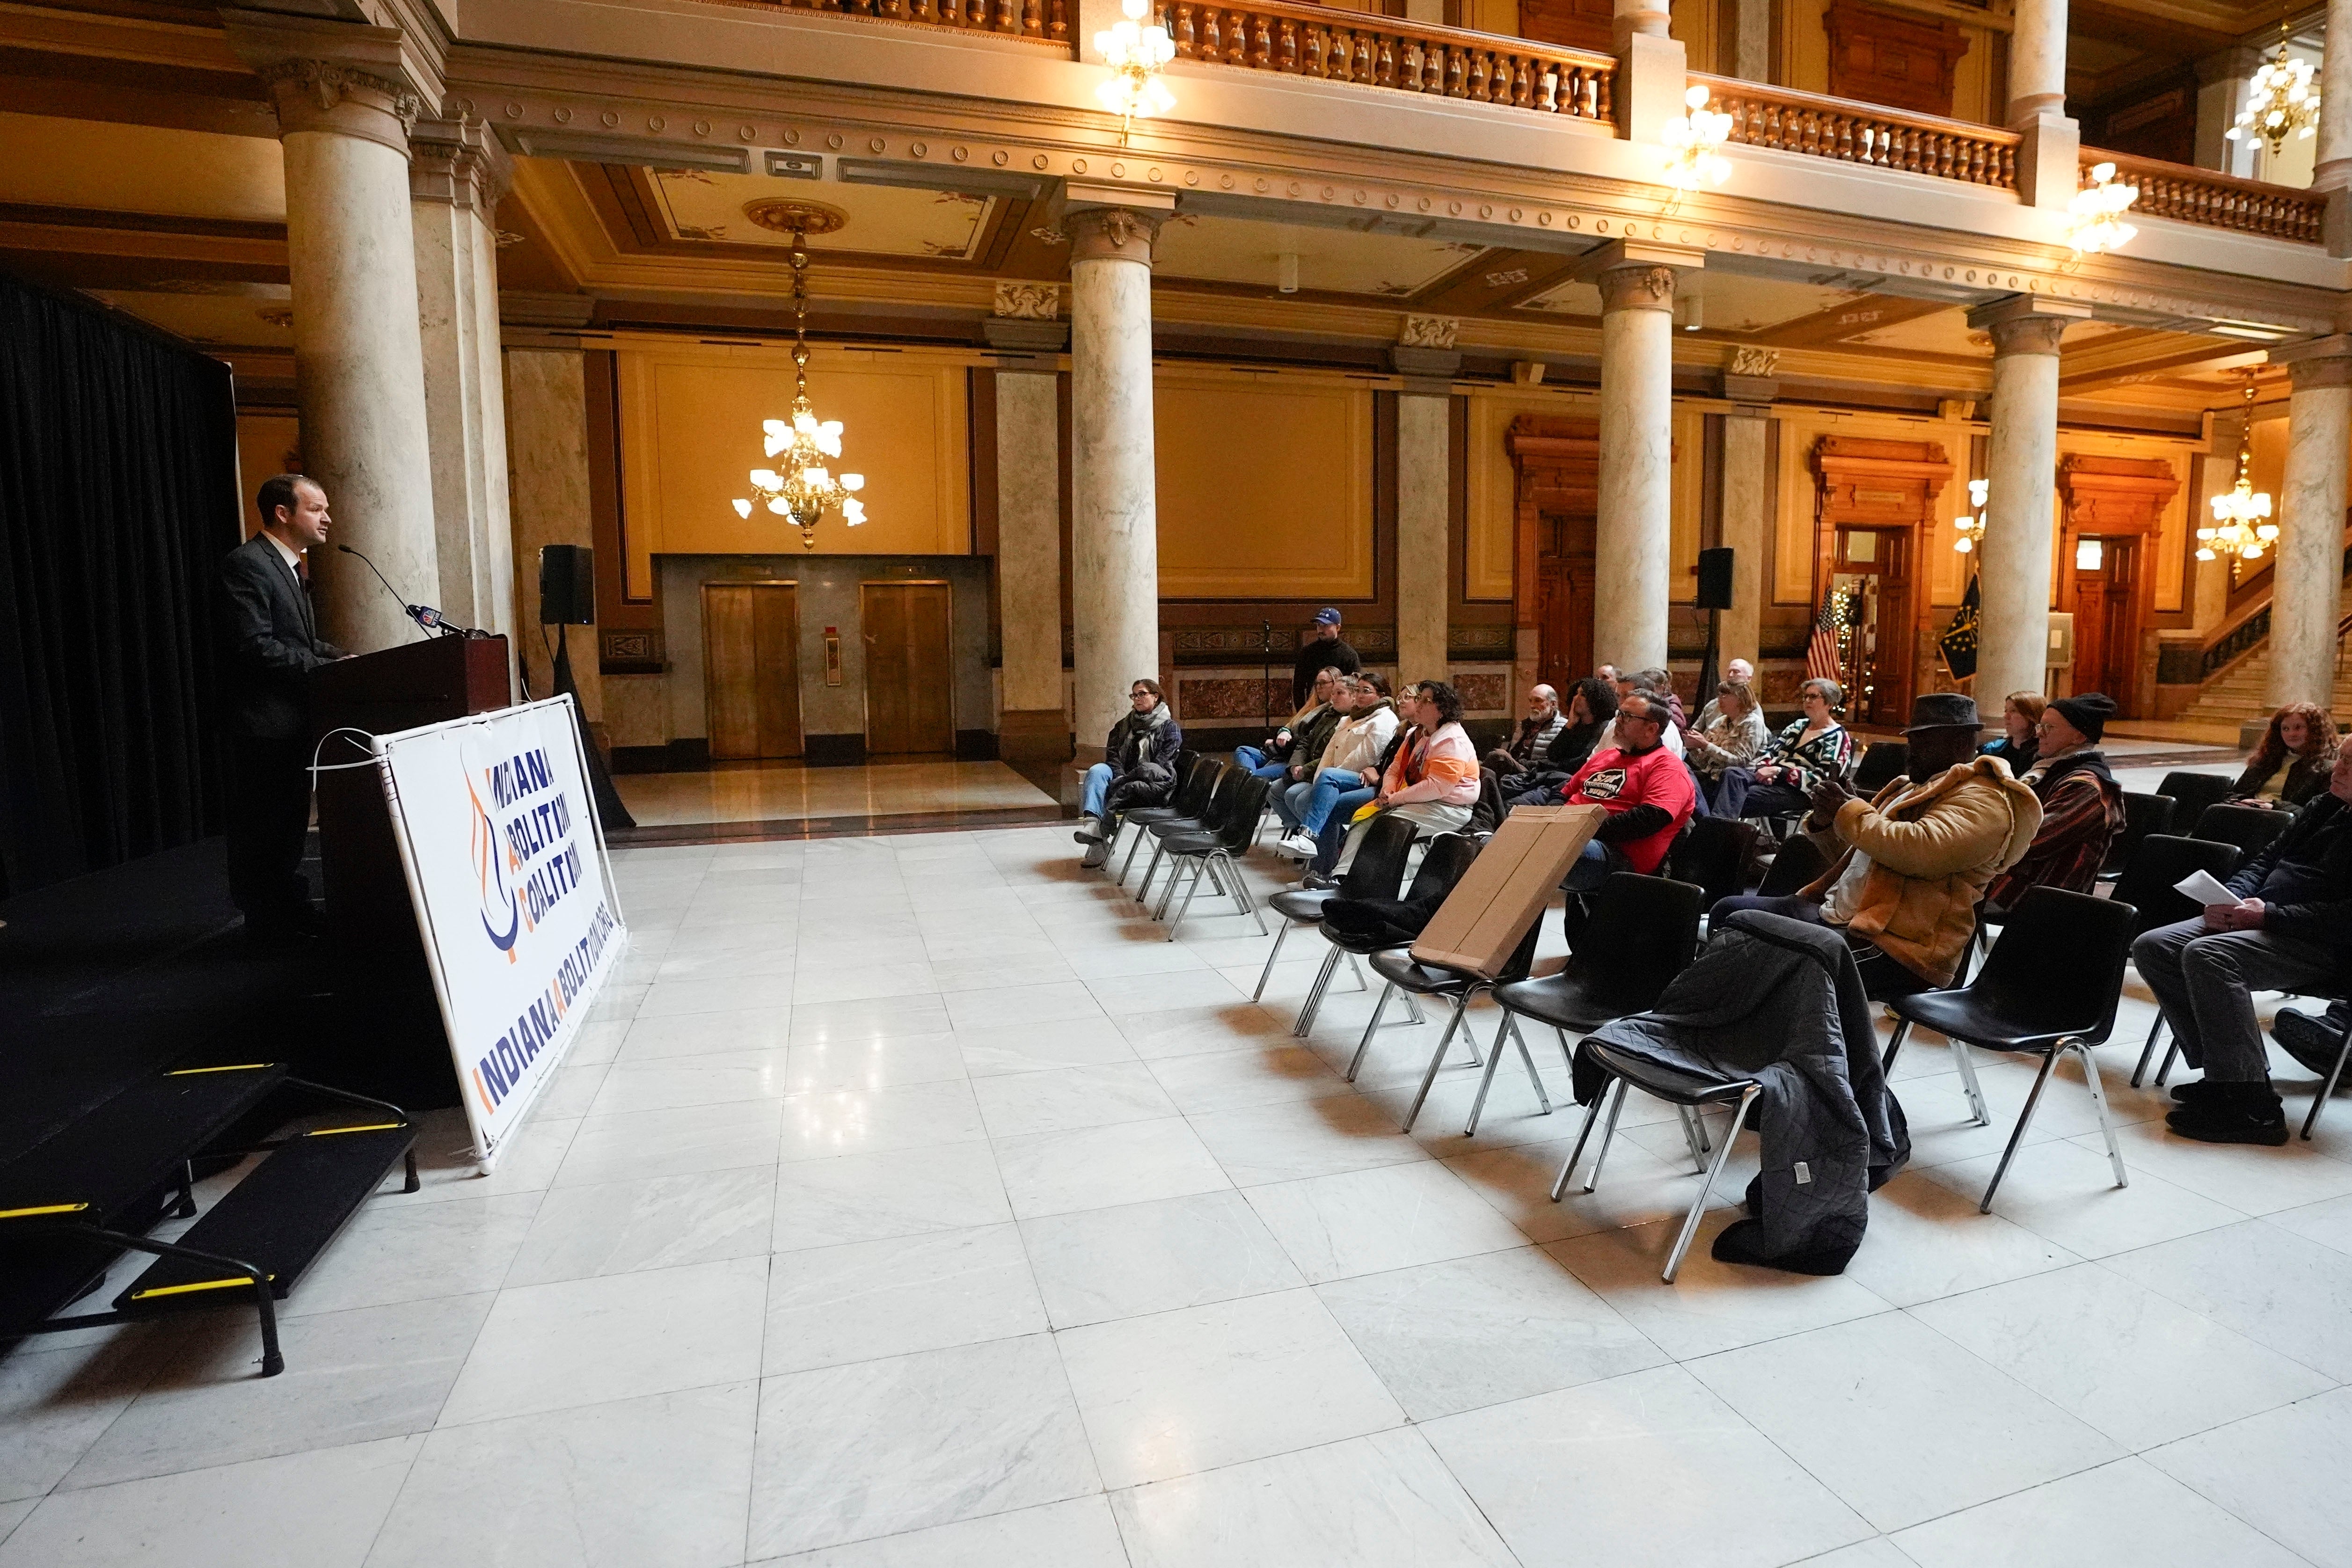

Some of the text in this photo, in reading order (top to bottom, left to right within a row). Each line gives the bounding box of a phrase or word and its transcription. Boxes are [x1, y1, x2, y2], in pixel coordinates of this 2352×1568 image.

[431, 612, 440, 626] WTHR
[485, 746, 554, 813] INDIANA
[504, 791, 570, 875] ABOLITION
[519, 839, 582, 933] COALITION
[472, 900, 614, 1116] INDIANAABOLITION.ORG
